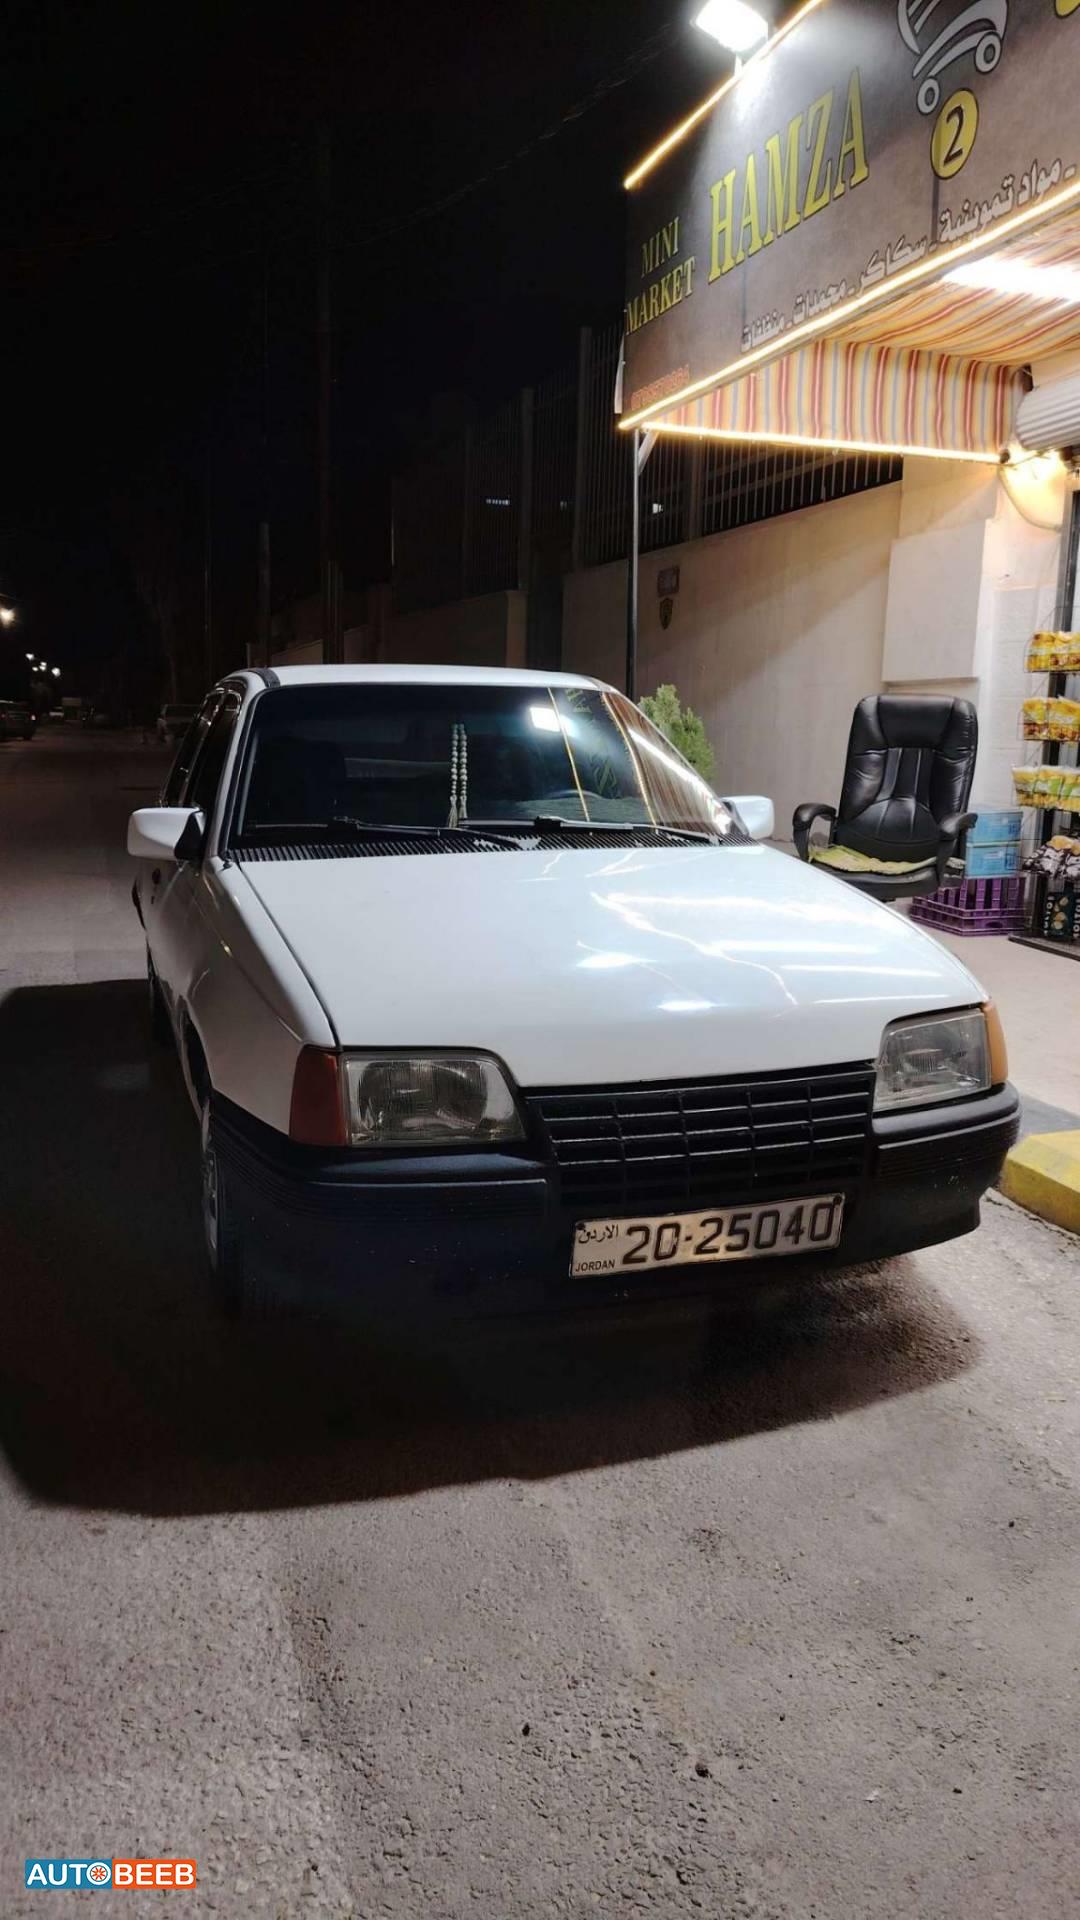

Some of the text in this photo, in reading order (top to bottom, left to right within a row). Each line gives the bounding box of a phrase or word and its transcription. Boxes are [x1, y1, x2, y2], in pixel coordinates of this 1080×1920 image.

[943, 104, 965, 168] 2
[708, 66, 870, 285] HAMZA
[1016, 157, 1063, 206] مواد
[641, 215, 680, 280] MINI
[857, 234, 928, 298] سكاكر
[625, 255, 696, 336] MARKET
[575, 1259, 616, 1272] JORDAN
[622, 1202, 834, 1265] 20-25040
